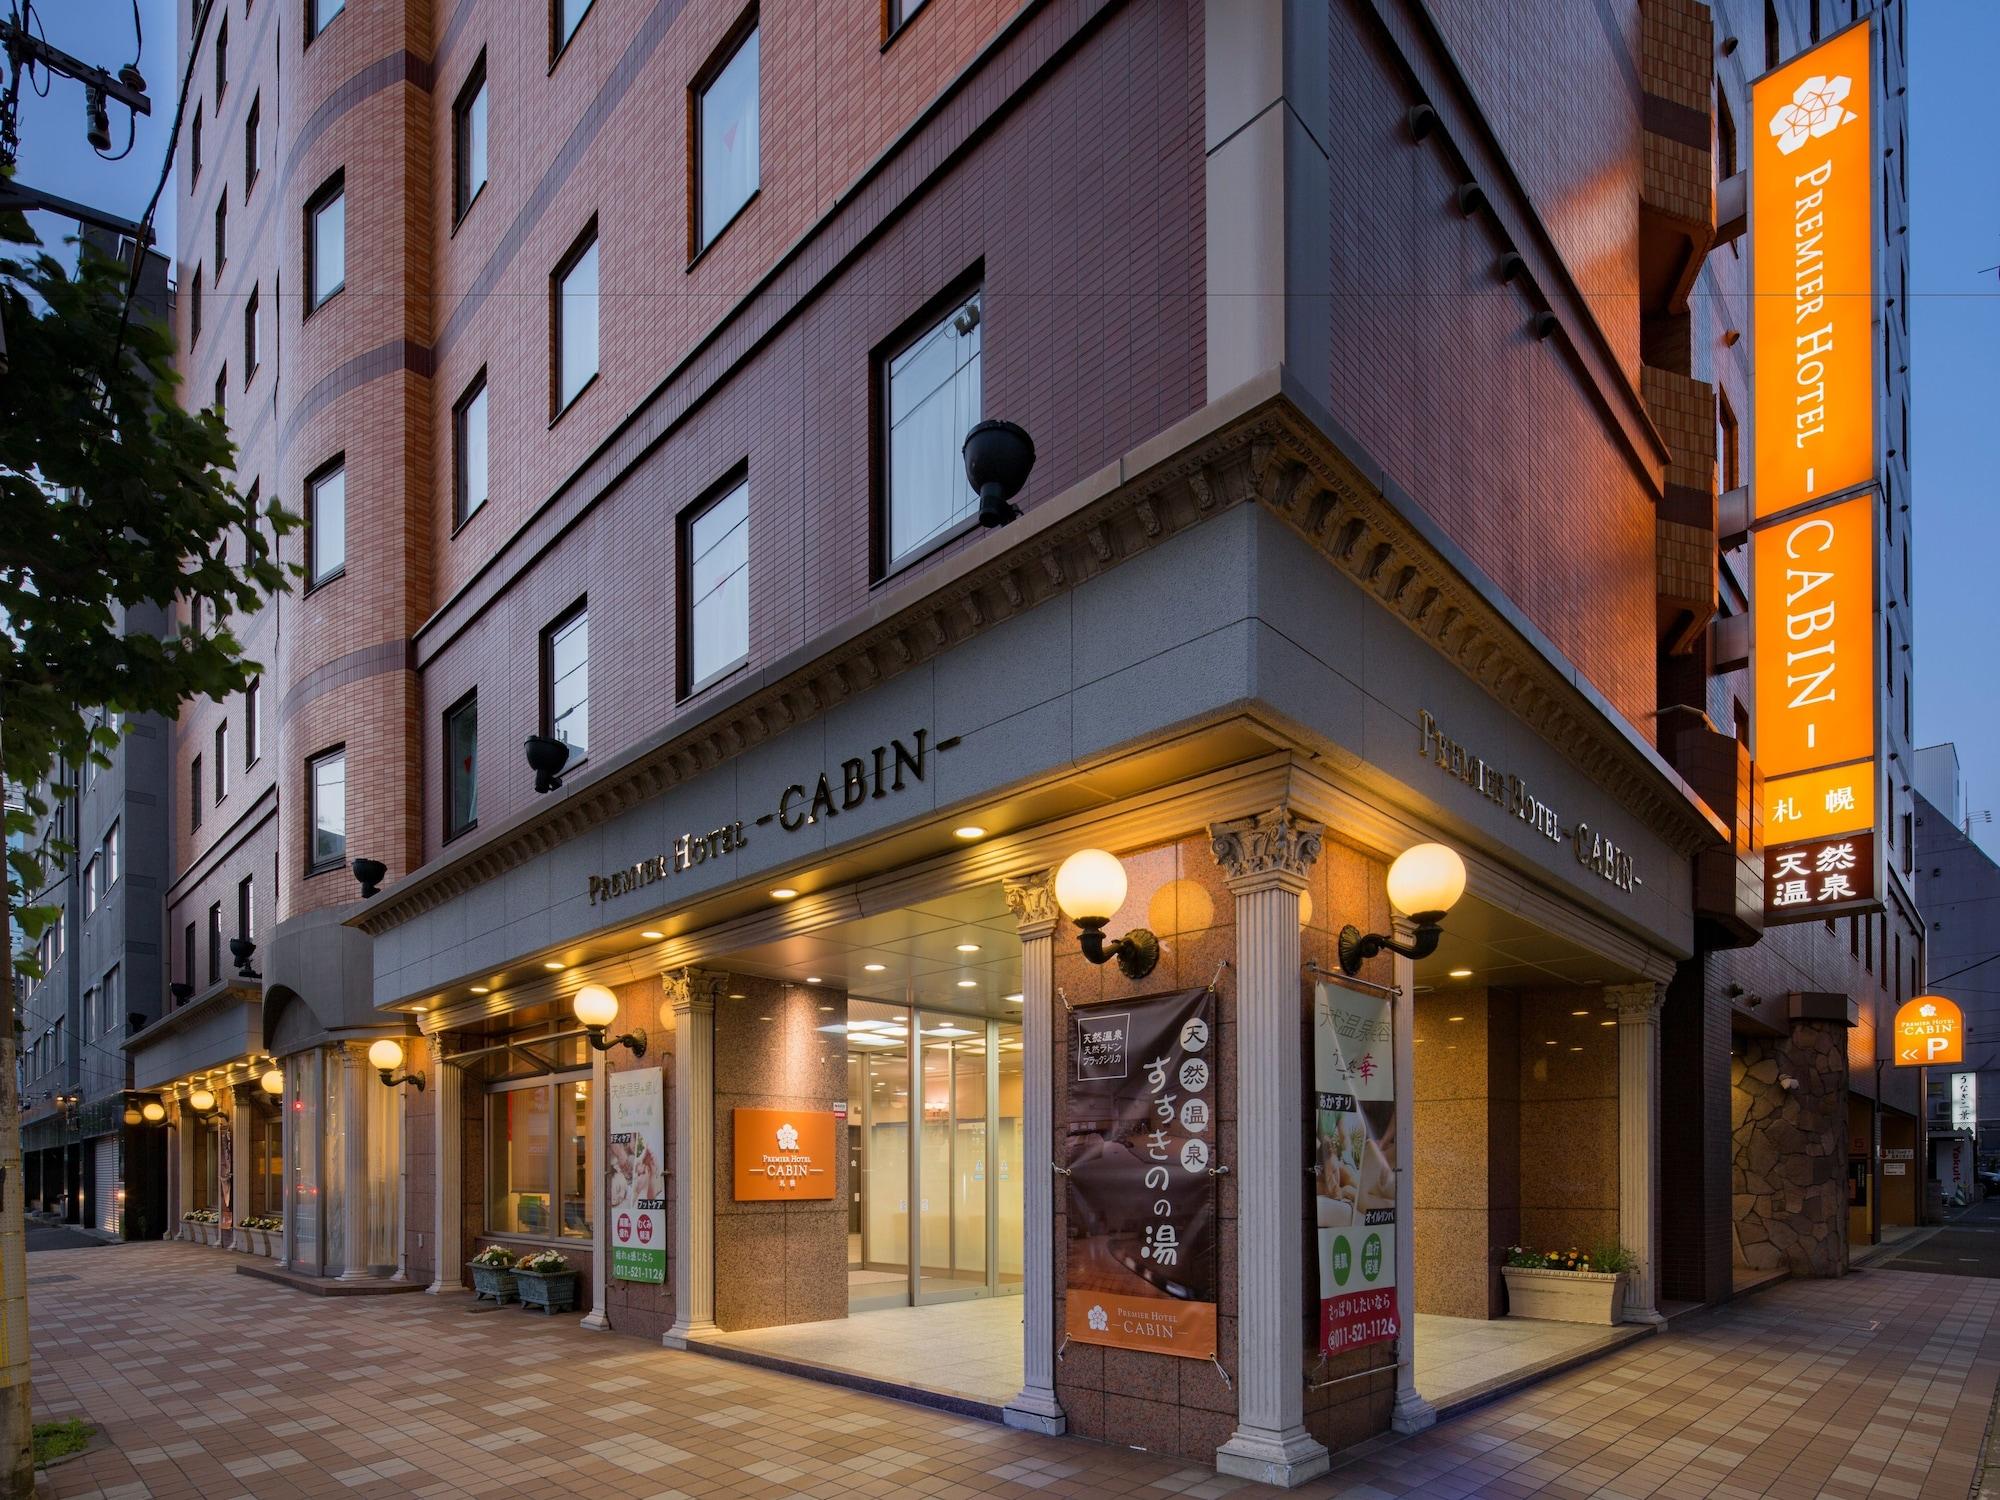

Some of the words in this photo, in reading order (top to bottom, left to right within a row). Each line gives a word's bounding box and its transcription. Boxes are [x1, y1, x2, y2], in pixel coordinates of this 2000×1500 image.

[1795, 159, 1832, 326] PREMIER
[1796, 321, 1833, 449] HOTEL
[1771, 786, 1856, 824] 札幌
[588, 854, 668, 906] PREMIER
[673, 820, 748, 874] HOTEL
[1772, 842, 1857, 878] 天然
[1773, 872, 1857, 906] 温泉
[1083, 1029, 1124, 1044] 天然温泉
[1927, 1037, 1949, 1060] P
[1182, 1024, 1206, 1166] 天然温泉
[1319, 1094, 1352, 1110] あかすり
[763, 1154, 790, 1163] PREMIER
[791, 1154, 812, 1163] HOTEL
[1141, 1056, 1180, 1266] すすきのの湯
[1953, 1145, 1961, 1183] Yakult
[1117, 1307, 1150, 1320] PREMIER
[1151, 1311, 1179, 1324] HOTEL
